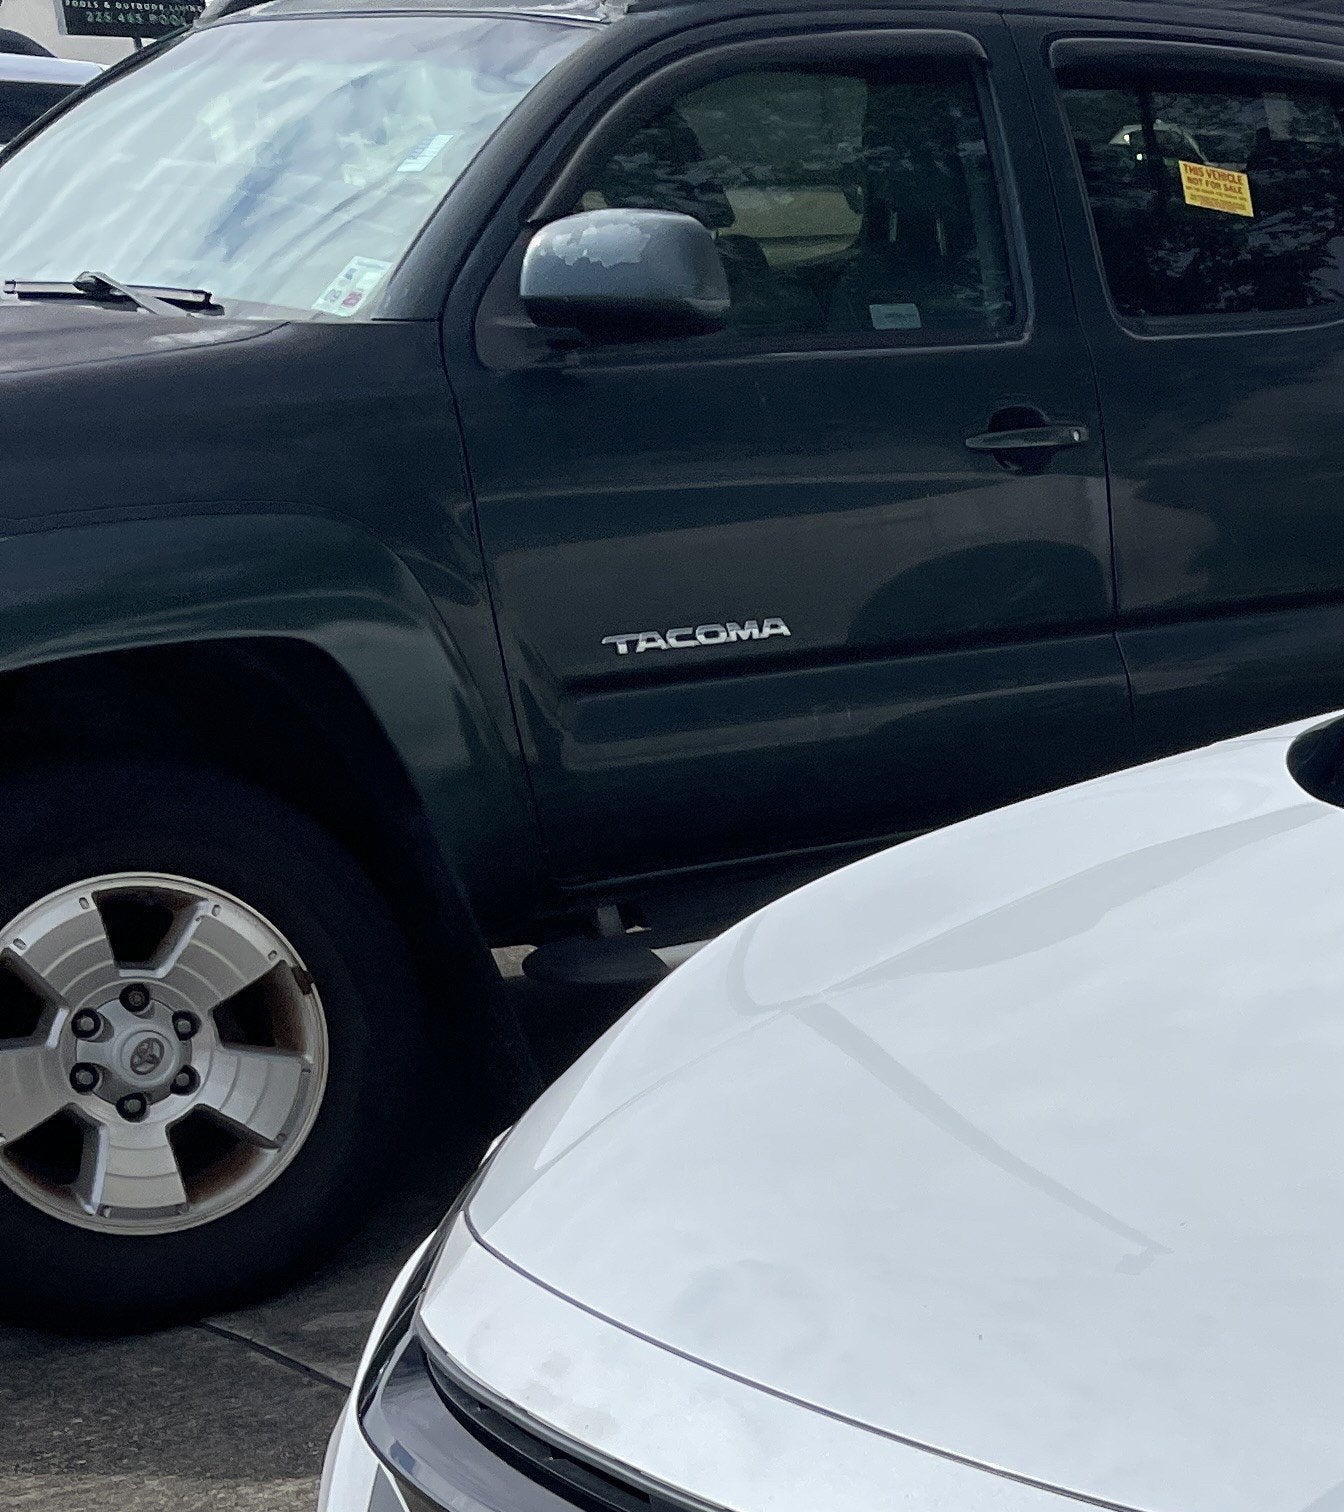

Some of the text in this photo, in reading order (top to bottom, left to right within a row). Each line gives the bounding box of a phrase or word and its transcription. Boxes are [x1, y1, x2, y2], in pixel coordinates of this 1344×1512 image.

[103, 1, 111, 9] &
[115, 1, 164, 11] OUTDOOR
[1183, 164, 1244, 186] THIS VEHICLE
[1187, 176, 1243, 195] NOT FOR SALE
[601, 617, 792, 654] TACOMA
